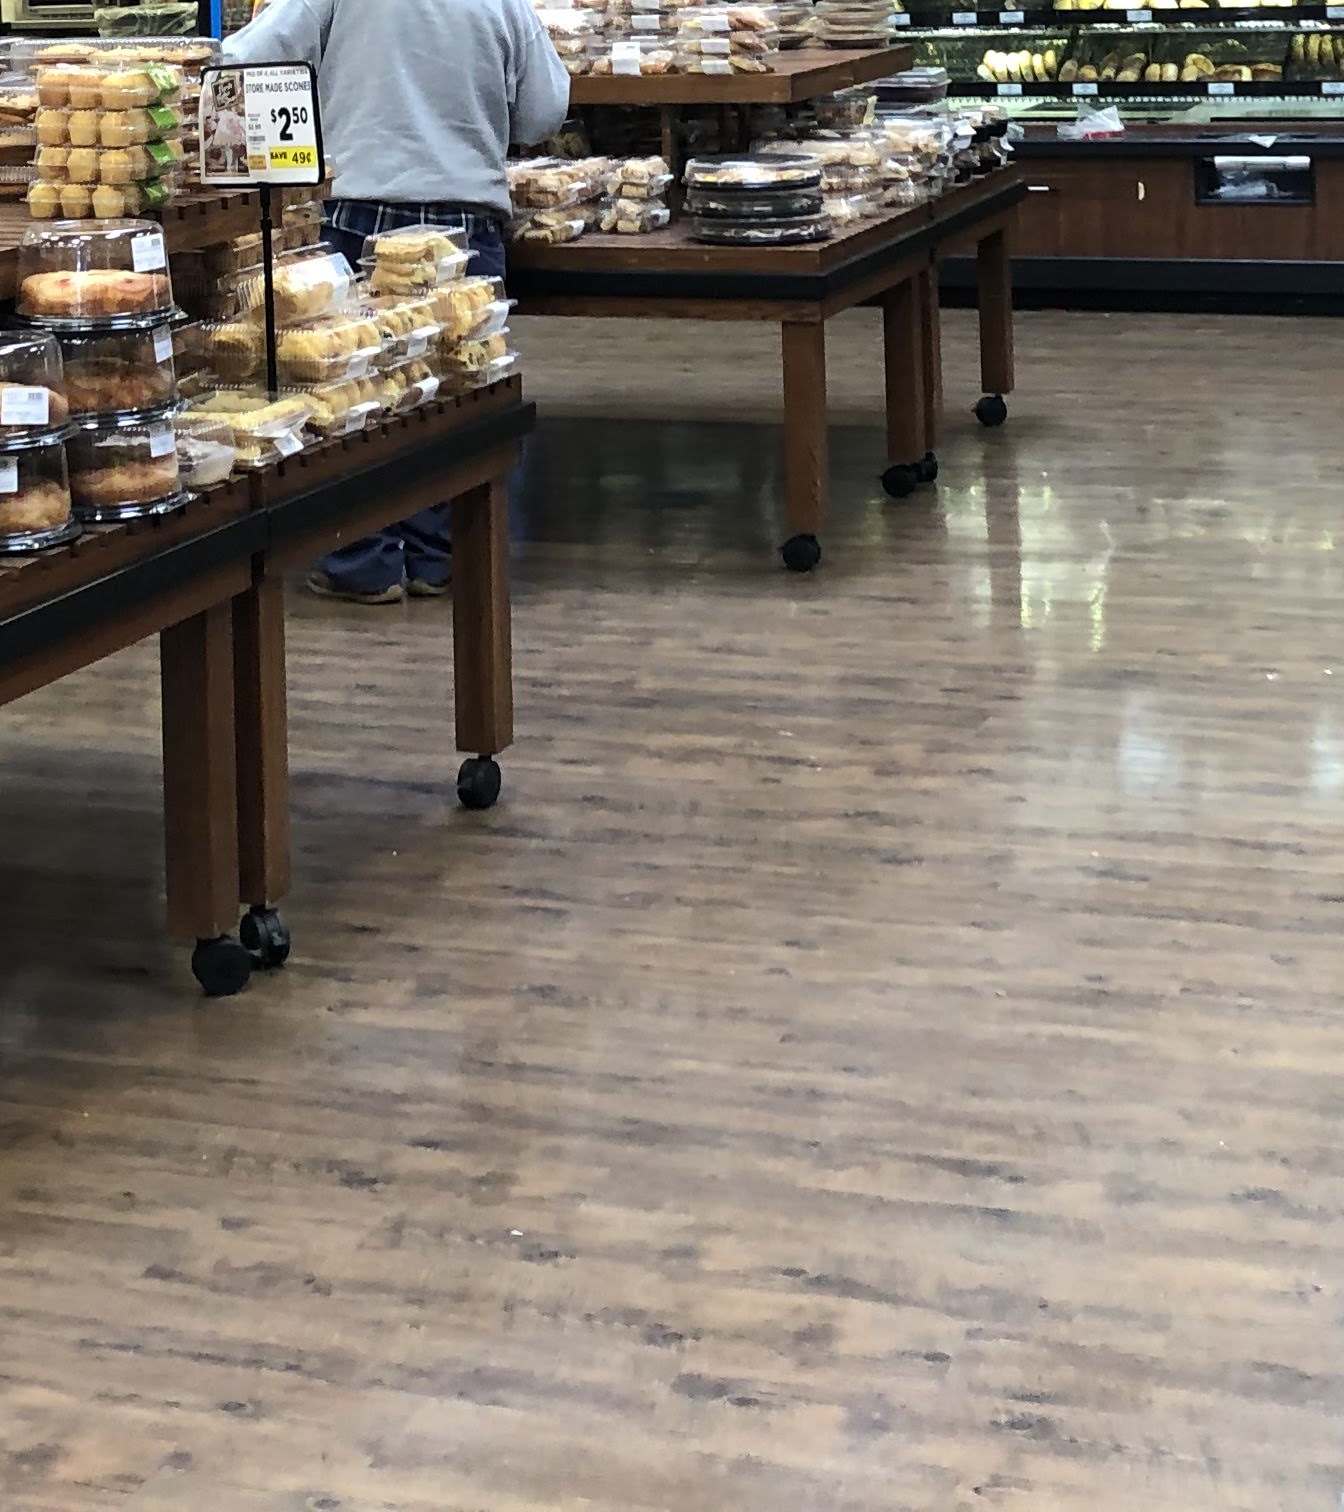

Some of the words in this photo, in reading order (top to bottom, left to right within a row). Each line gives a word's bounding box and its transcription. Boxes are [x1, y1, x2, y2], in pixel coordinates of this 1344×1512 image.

[265, 82, 283, 93] MADE
[271, 151, 288, 160] SAVE
[291, 151, 312, 165] 49¢
